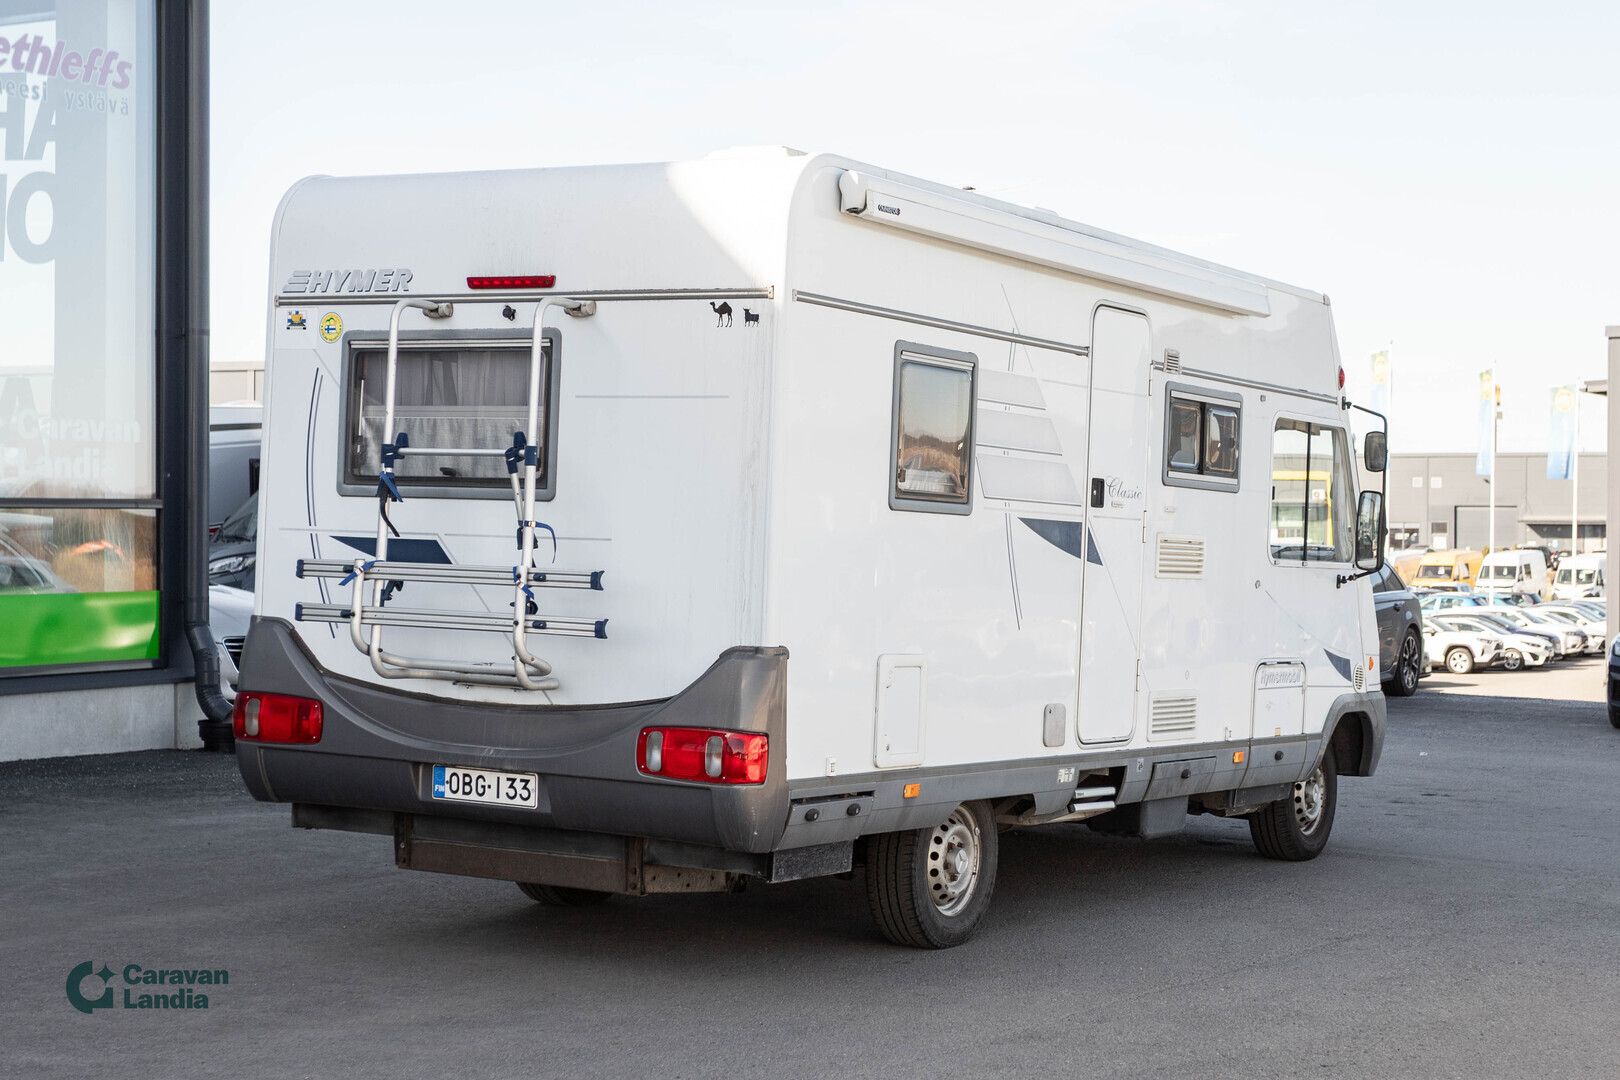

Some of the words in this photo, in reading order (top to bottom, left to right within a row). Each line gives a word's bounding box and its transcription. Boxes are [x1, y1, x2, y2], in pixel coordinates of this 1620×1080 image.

[0, 79, 48, 101] eesi
[64, 88, 130, 117] ystävä
[306, 267, 414, 294] HYMER
[1105, 475, 1143, 500] Classic
[434, 784, 445, 792] FIN
